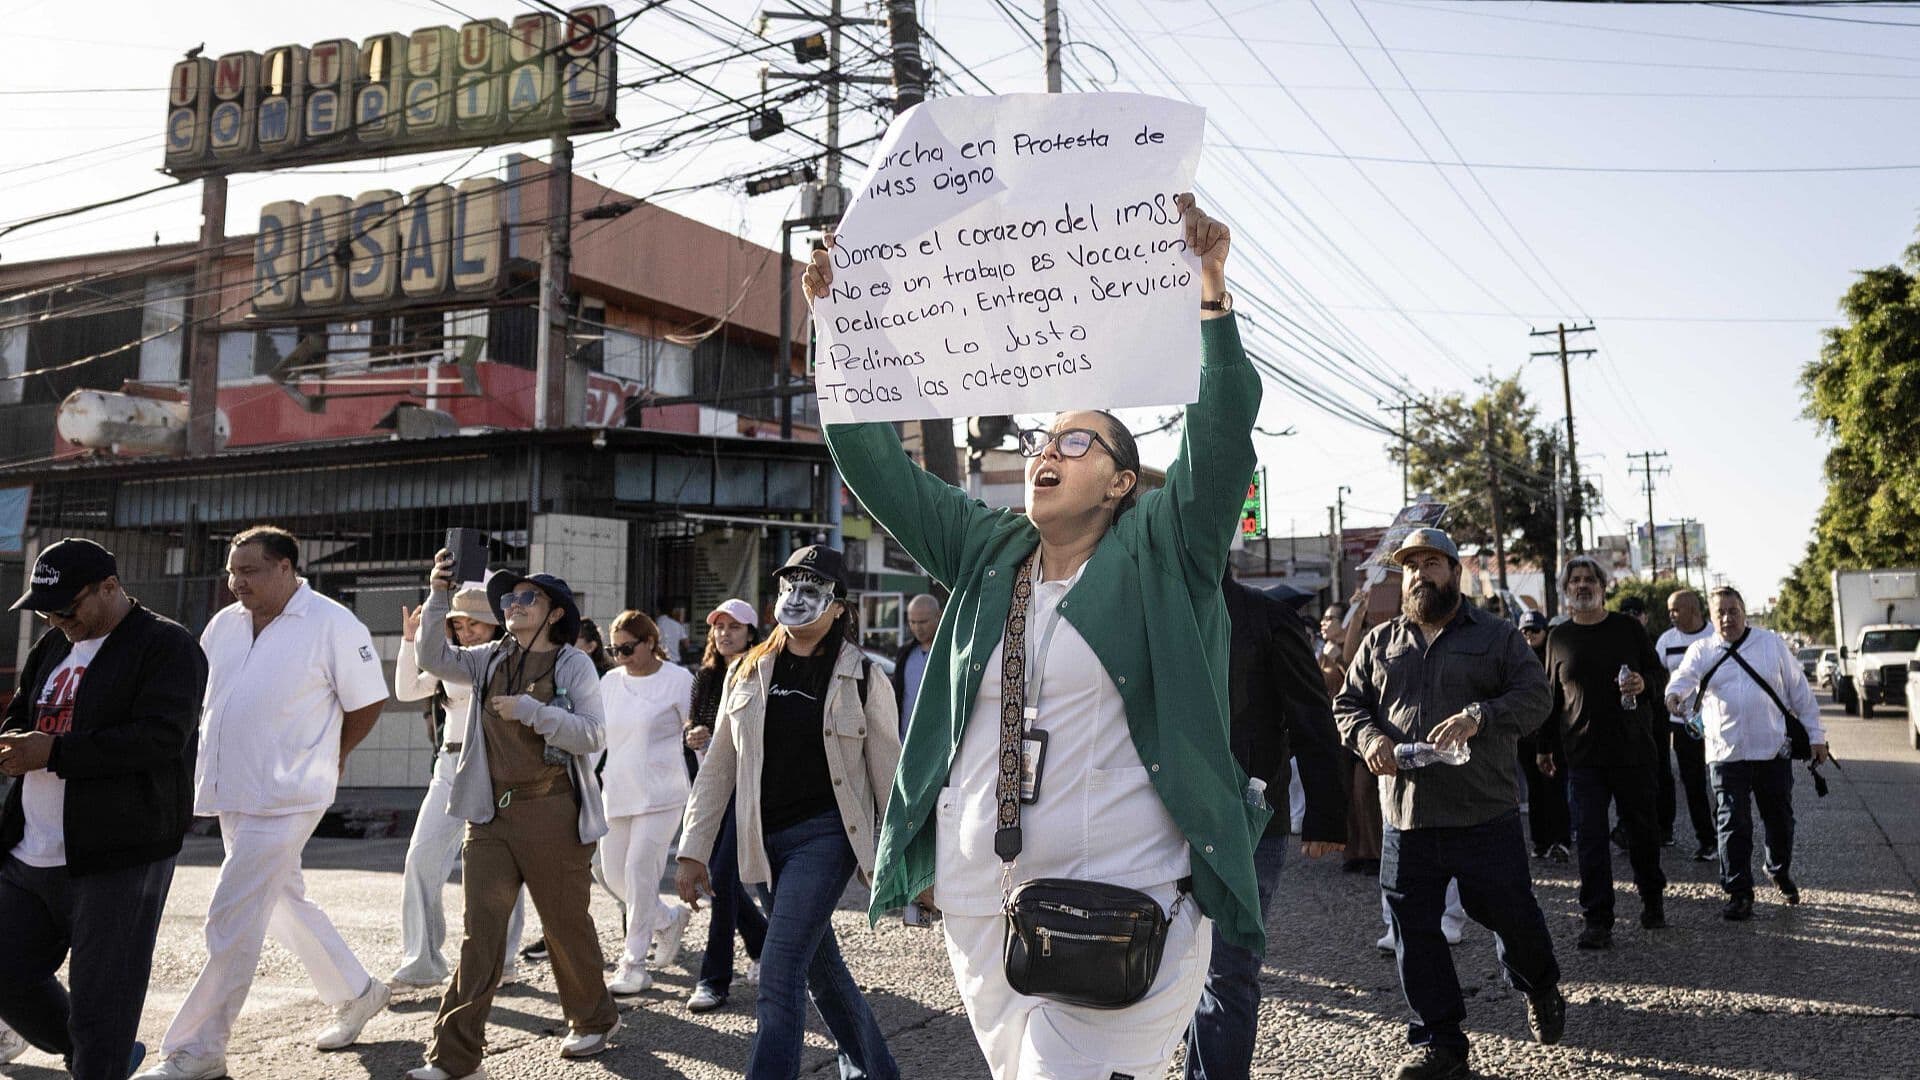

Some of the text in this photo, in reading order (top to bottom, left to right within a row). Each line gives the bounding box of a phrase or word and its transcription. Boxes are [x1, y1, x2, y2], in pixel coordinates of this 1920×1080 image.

[178, 13, 597, 103] INTTUTO
[168, 63, 591, 149] COMERCIAL
[960, 139, 996, 159] en
[1013, 128, 1109, 155] Protesta
[1134, 125, 1165, 146] de
[254, 188, 486, 298] RASAL
[834, 233, 907, 269] Somos
[919, 230, 942, 255] el
[1055, 202, 1099, 234] del
[832, 281, 862, 304] No
[869, 281, 891, 297] es
[904, 275, 931, 292] un
[943, 259, 1015, 286] trabajo
[1031, 253, 1055, 272] es
[1090, 263, 1191, 301] Servicio
[917, 376, 949, 396] las
